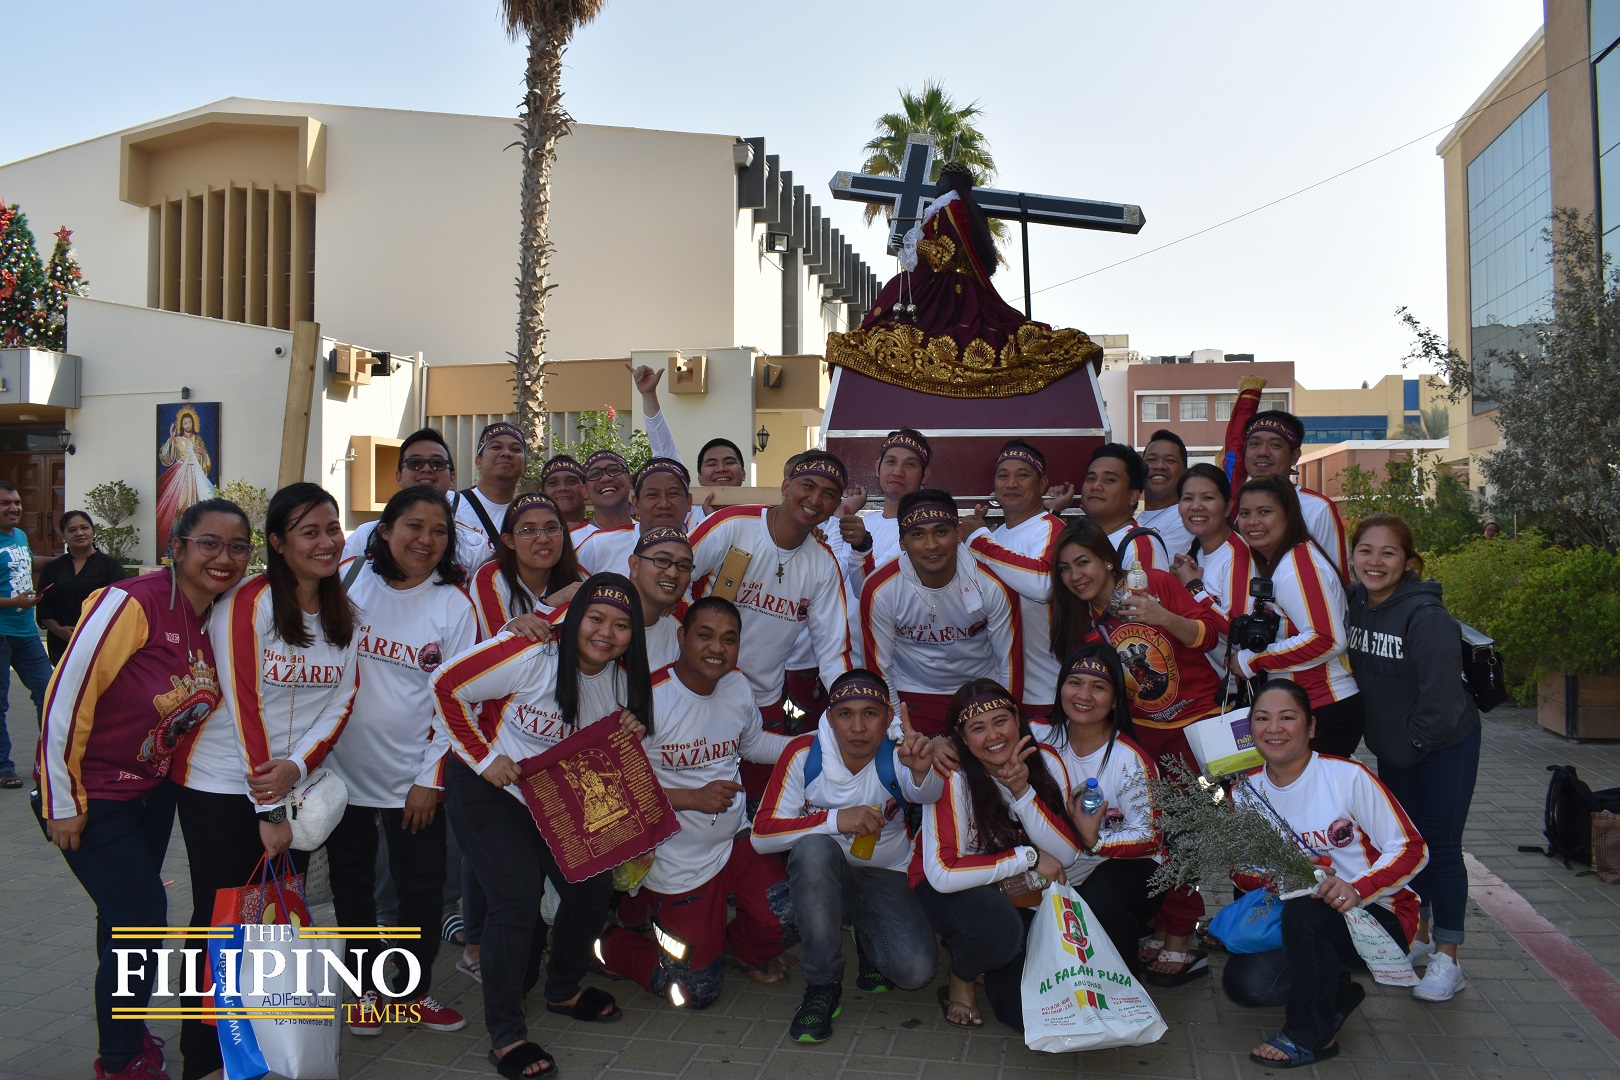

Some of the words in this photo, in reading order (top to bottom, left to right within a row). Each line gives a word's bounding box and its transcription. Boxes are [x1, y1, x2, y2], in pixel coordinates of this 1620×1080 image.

[749, 582, 763, 590] del
[1371, 631, 1404, 659] STATE
[660, 742, 691, 752] Hijos
[694, 737, 707, 747] del
[1040, 978, 1053, 994] AL
[1055, 965, 1094, 984] FALAH
[1097, 969, 1132, 987] PLAZA
